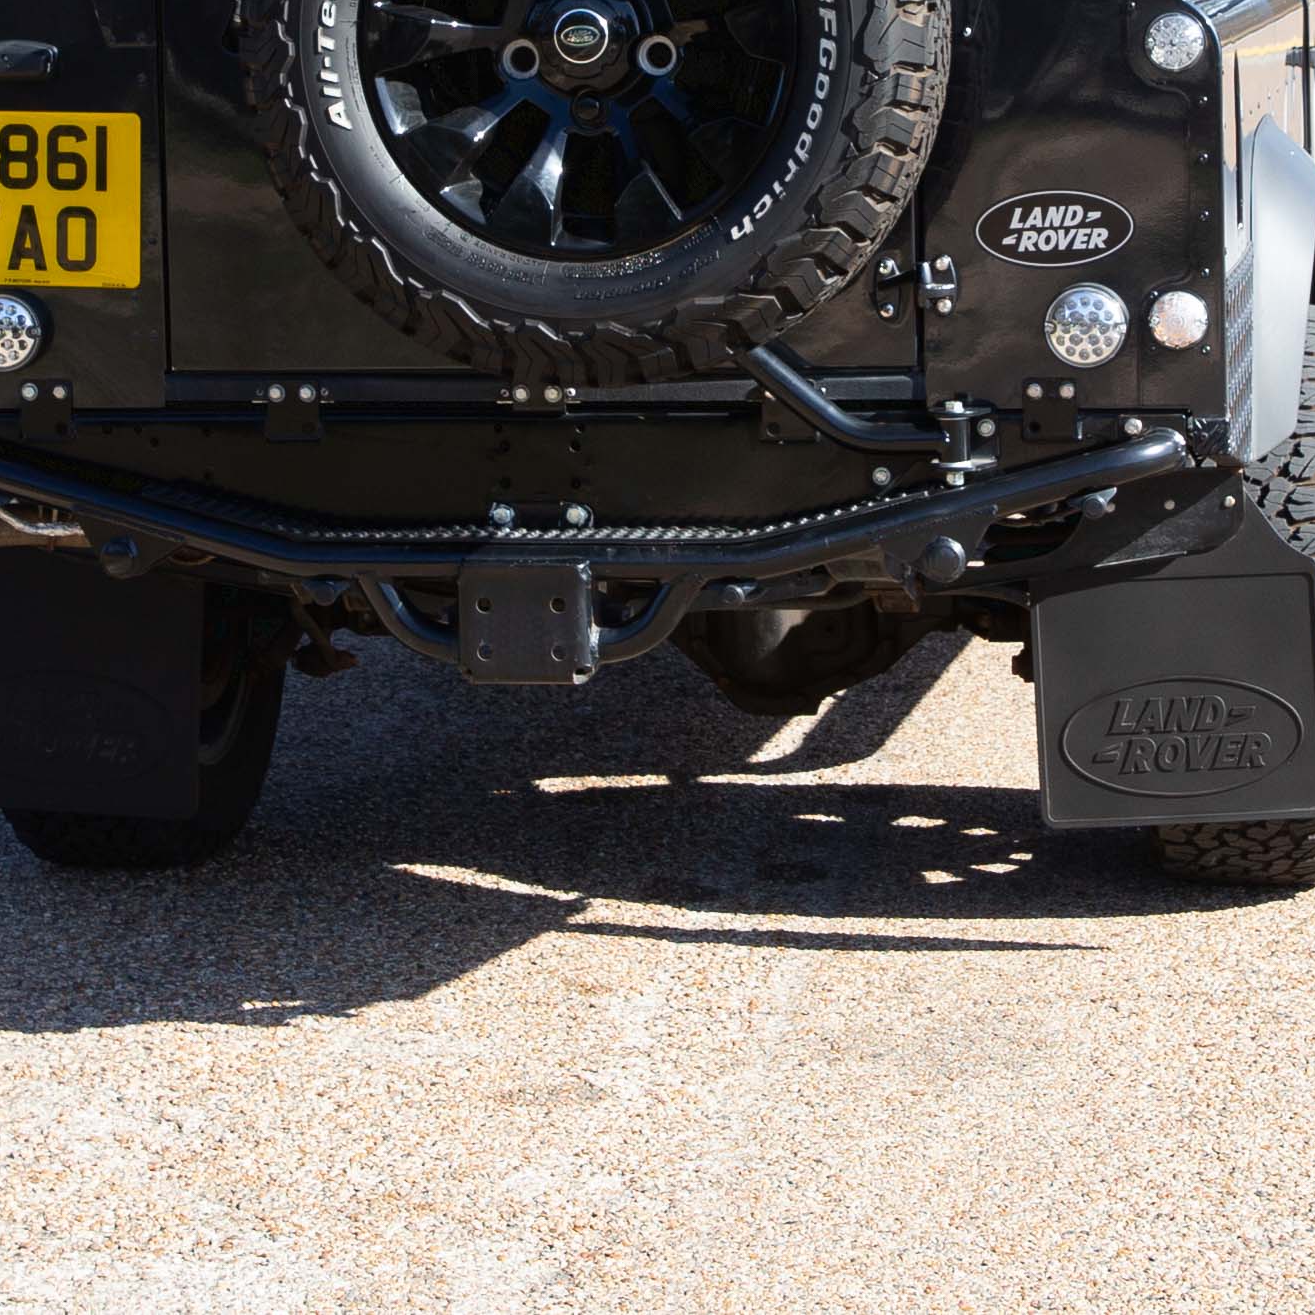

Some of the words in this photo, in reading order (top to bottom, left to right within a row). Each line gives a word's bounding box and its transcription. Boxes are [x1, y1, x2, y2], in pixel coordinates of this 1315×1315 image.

[1009, 204, 1085, 230] LAND
[1017, 227, 1109, 252] ROVER
[1104, 694, 1227, 736] LAND
[1117, 732, 1273, 776] ROVER
